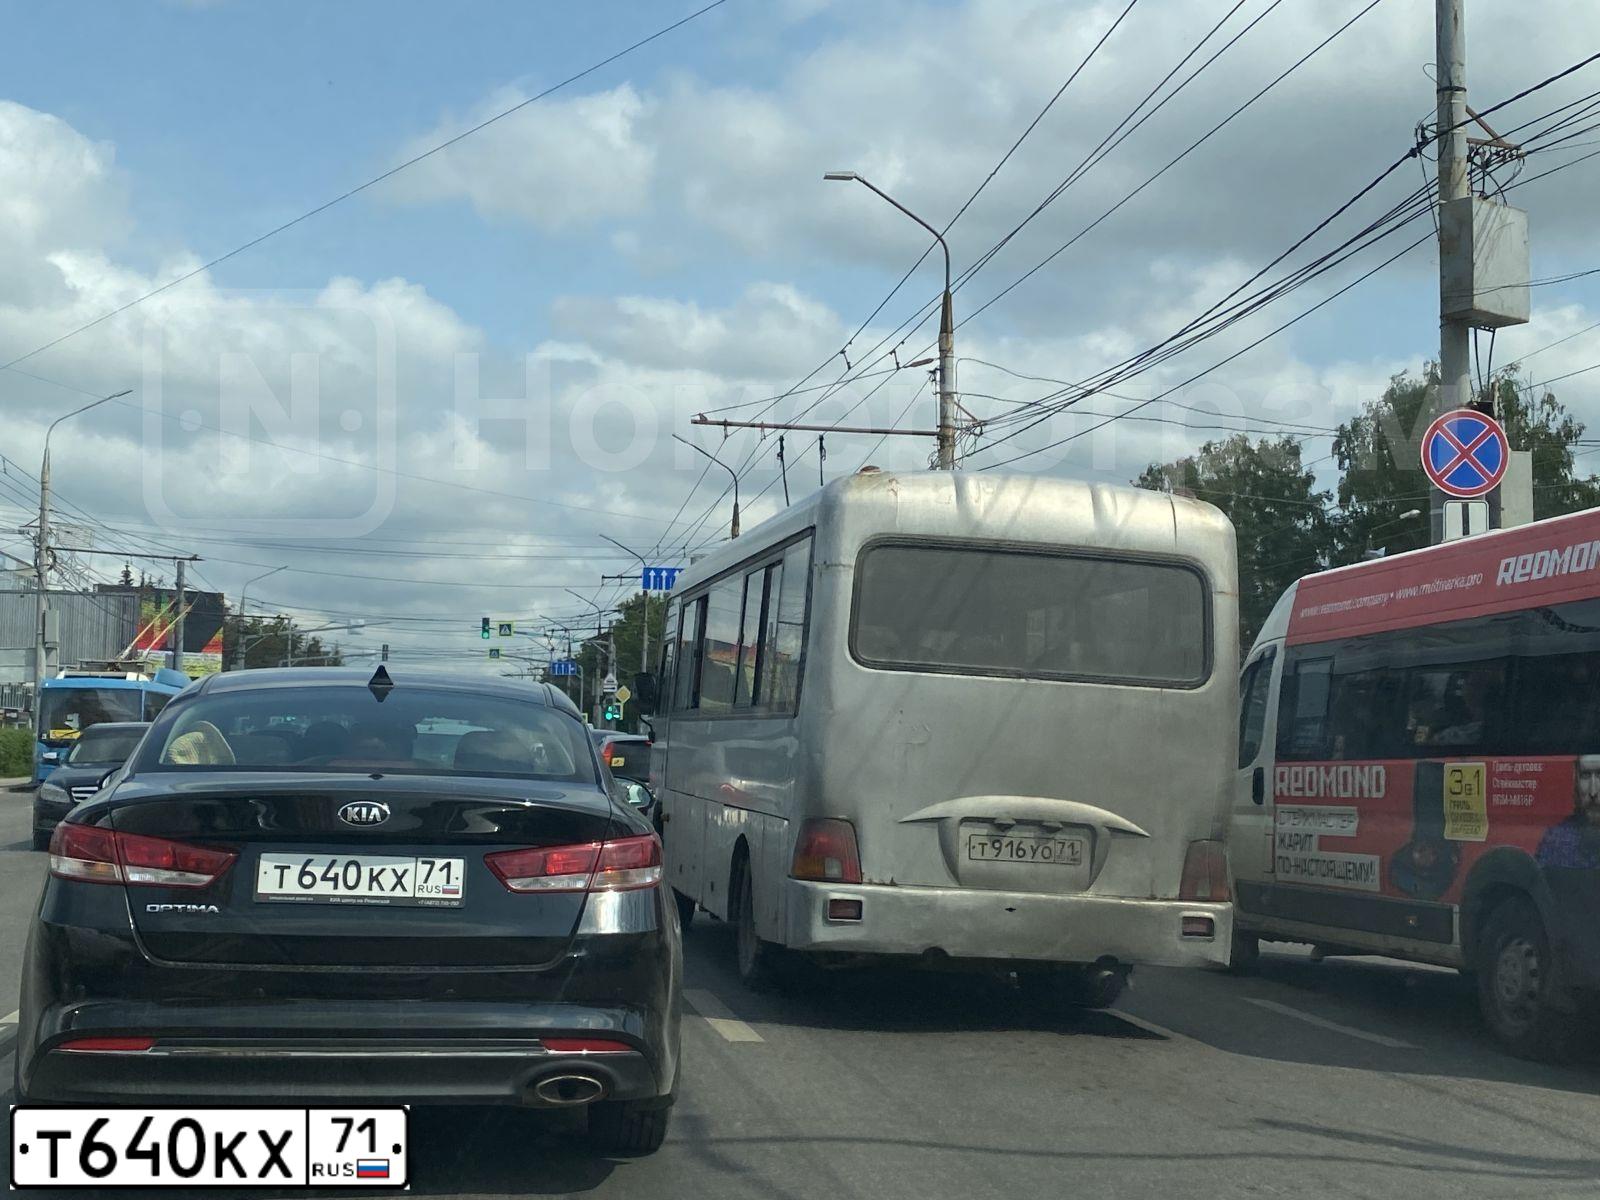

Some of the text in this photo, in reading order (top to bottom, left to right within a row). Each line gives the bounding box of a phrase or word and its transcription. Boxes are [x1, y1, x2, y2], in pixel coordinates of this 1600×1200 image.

[1275, 765, 1386, 799] REDMOND
[1449, 769, 1463, 795] 3
[1473, 769, 1480, 796] 1
[347, 806, 381, 822] KIA
[273, 858, 452, 893] Т640КХ 71
[417, 883, 441, 895] RUS
[146, 904, 219, 913] OPTIMA
